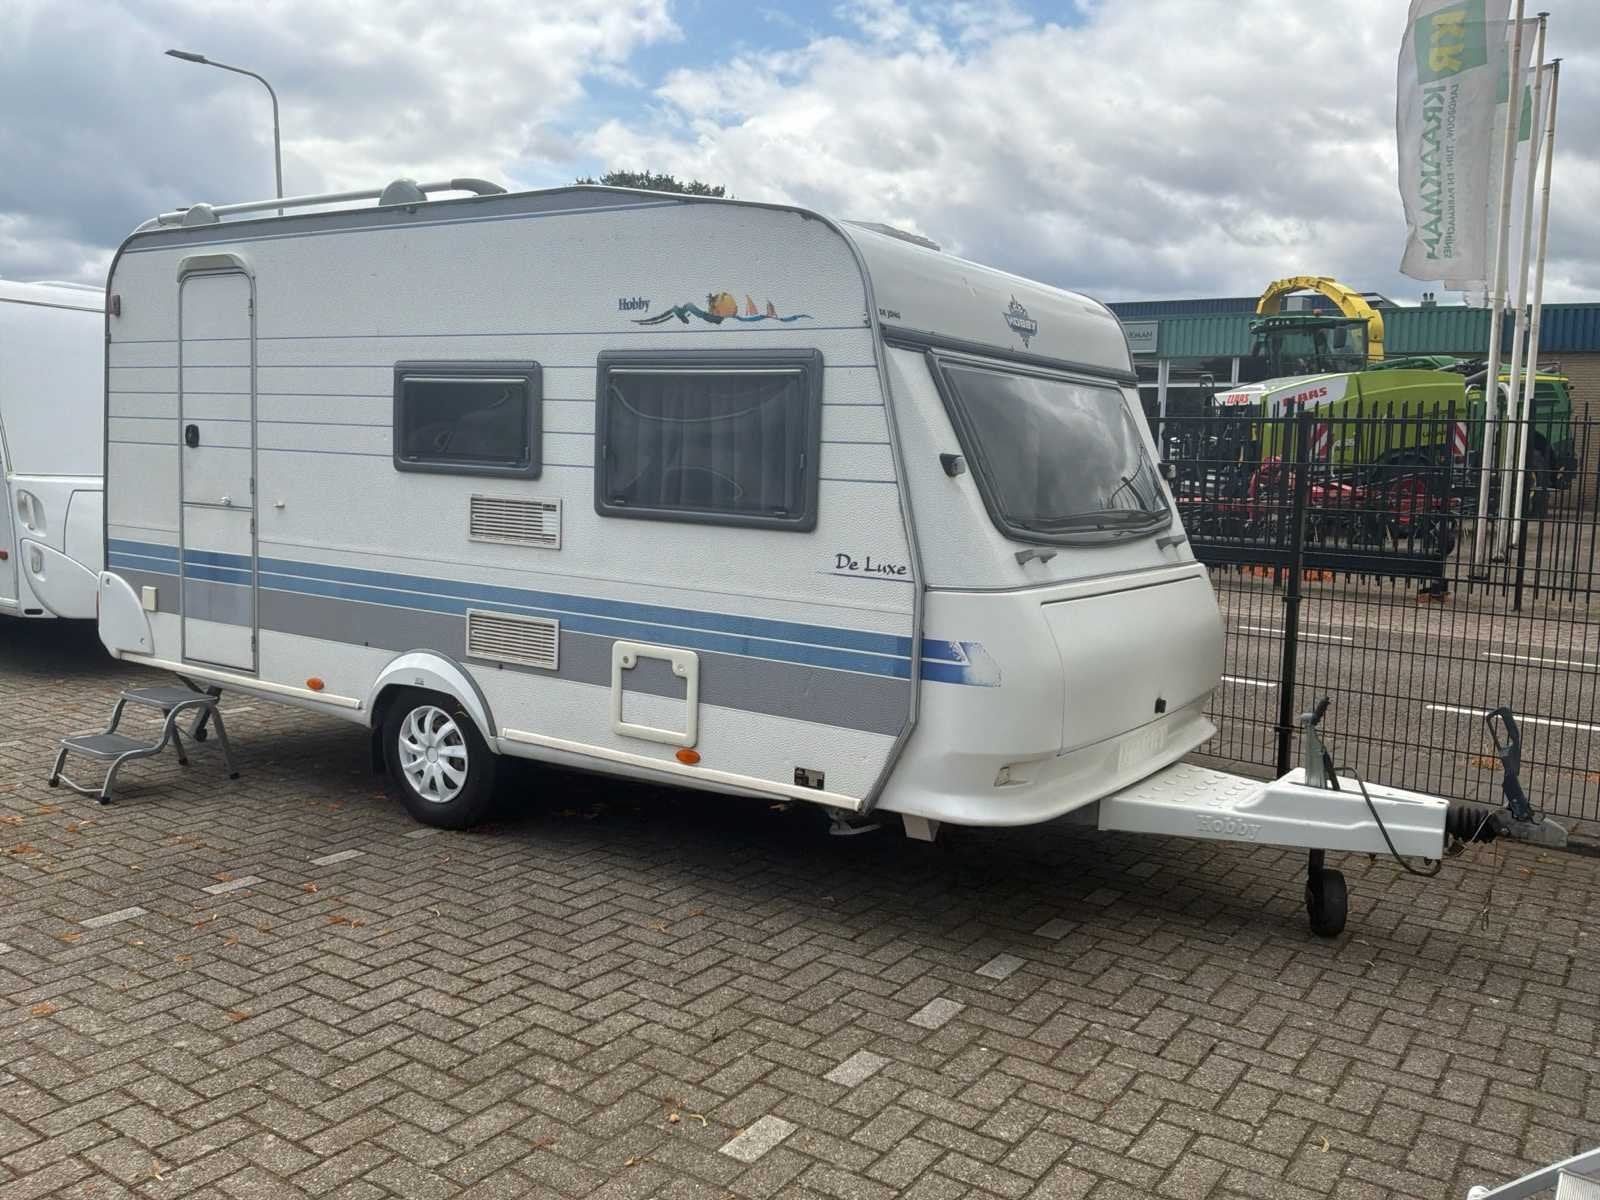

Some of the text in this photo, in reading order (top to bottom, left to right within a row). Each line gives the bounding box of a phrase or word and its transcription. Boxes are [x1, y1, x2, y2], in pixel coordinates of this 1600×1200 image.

[618, 297, 651, 312] Hobby
[835, 553, 906, 575] De Luxe
[1196, 813, 1262, 840] Hobby
